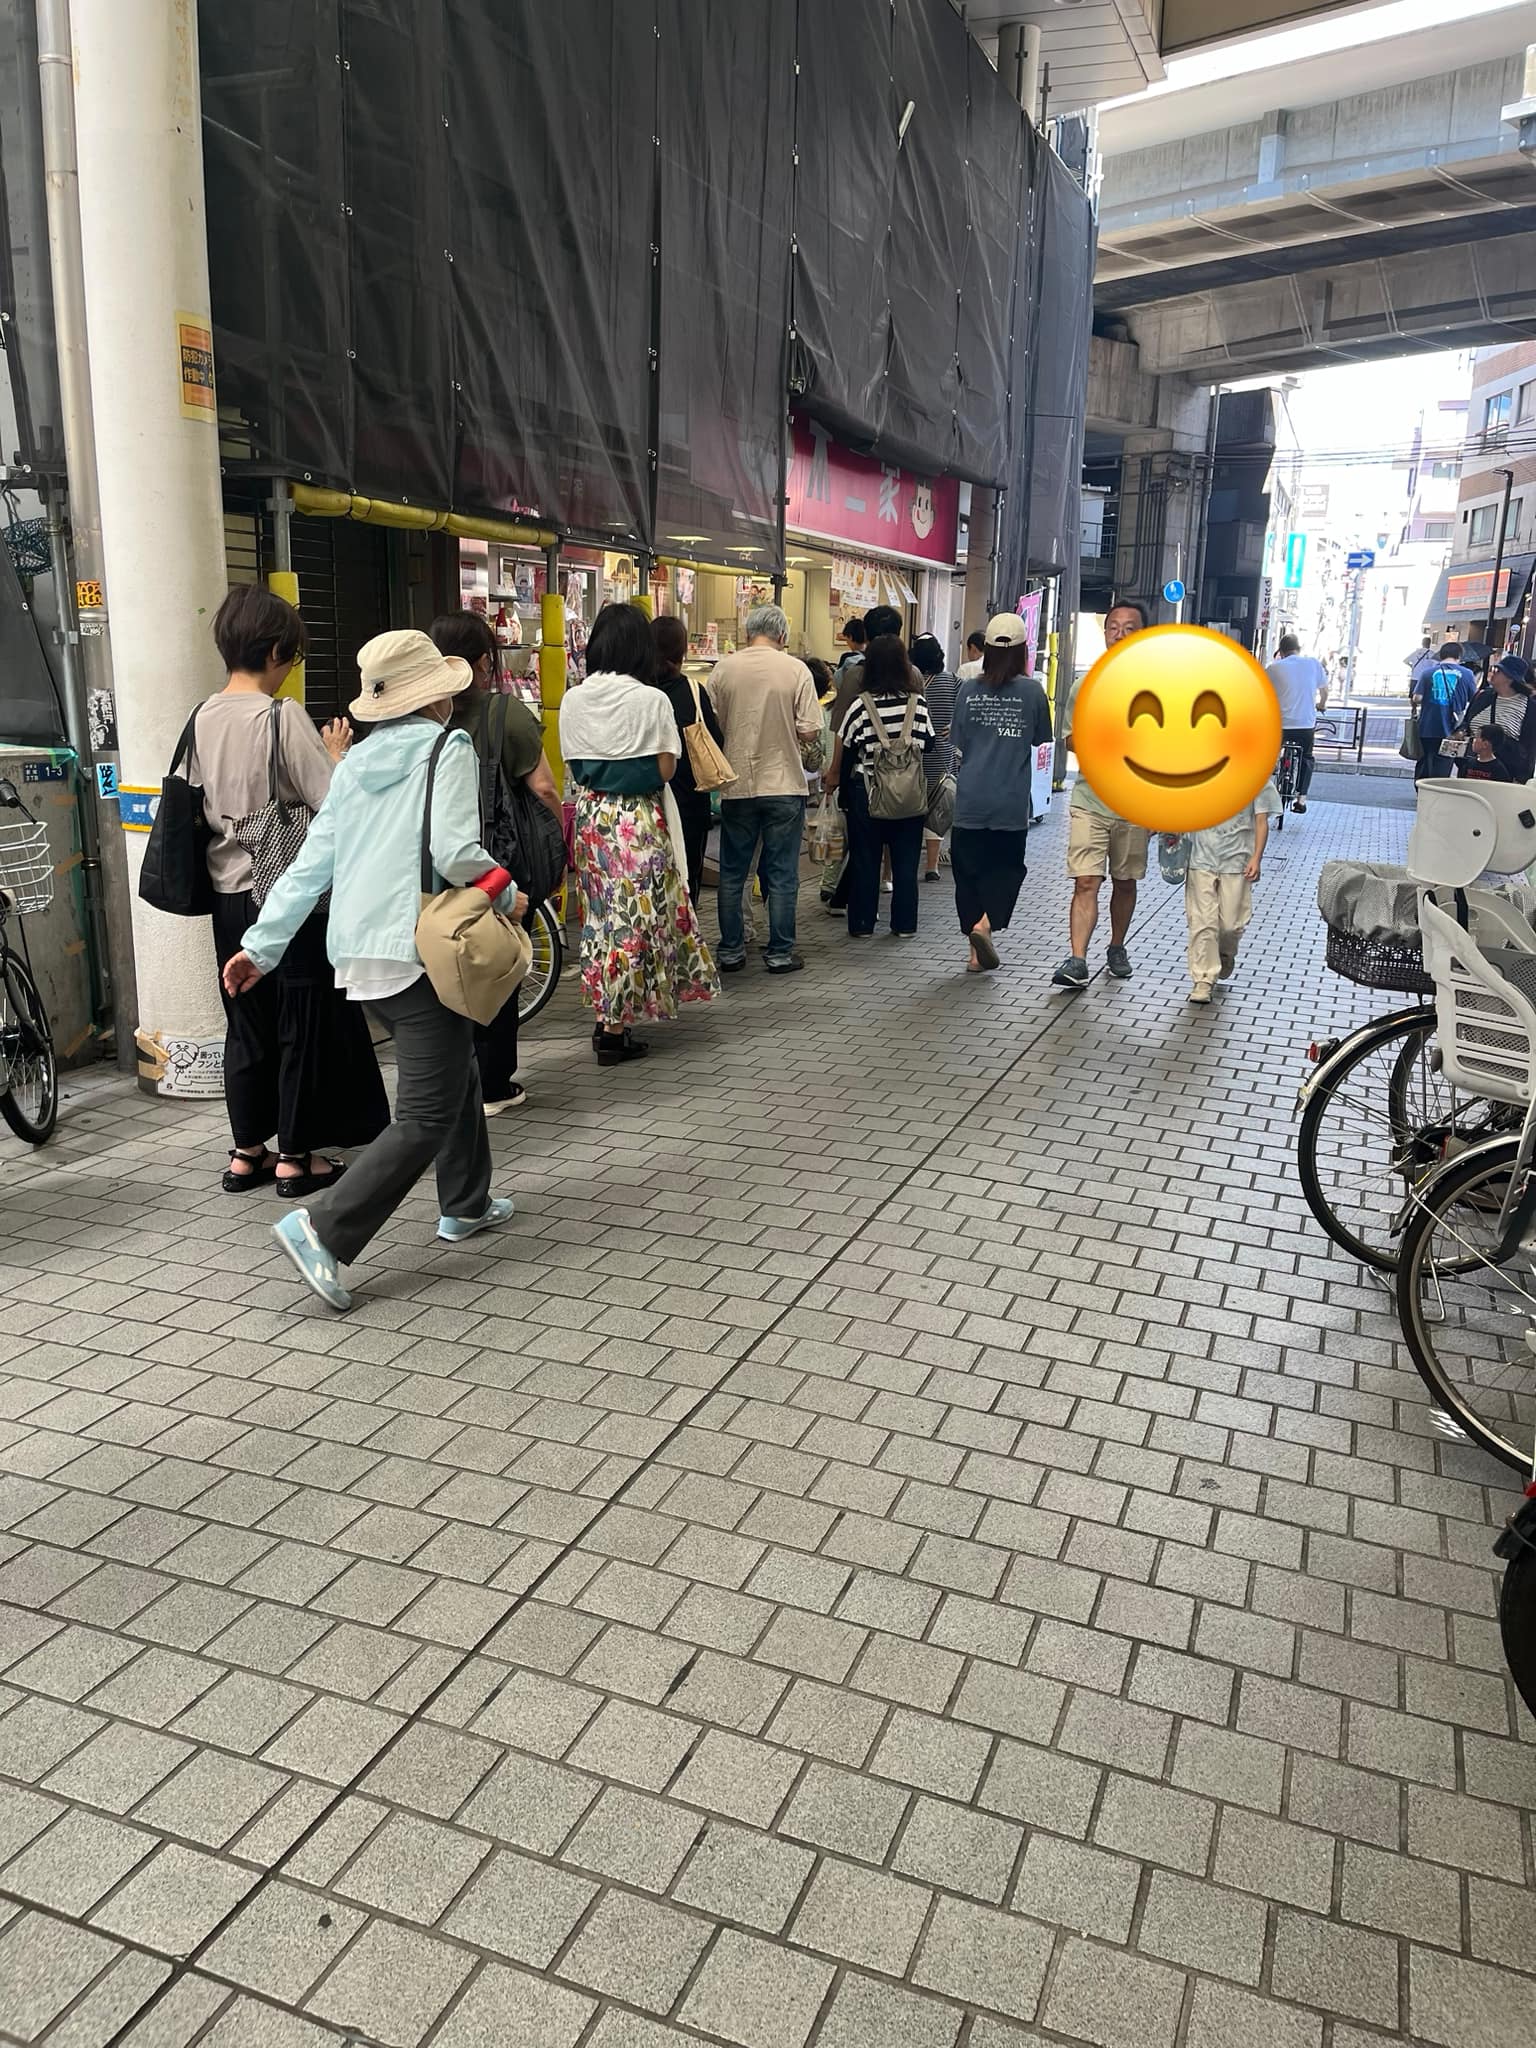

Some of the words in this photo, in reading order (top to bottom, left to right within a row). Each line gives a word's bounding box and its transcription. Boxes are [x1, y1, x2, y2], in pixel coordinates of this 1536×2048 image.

[998, 728, 1023, 737] YALE
[197, 1060, 225, 1068] フンと
